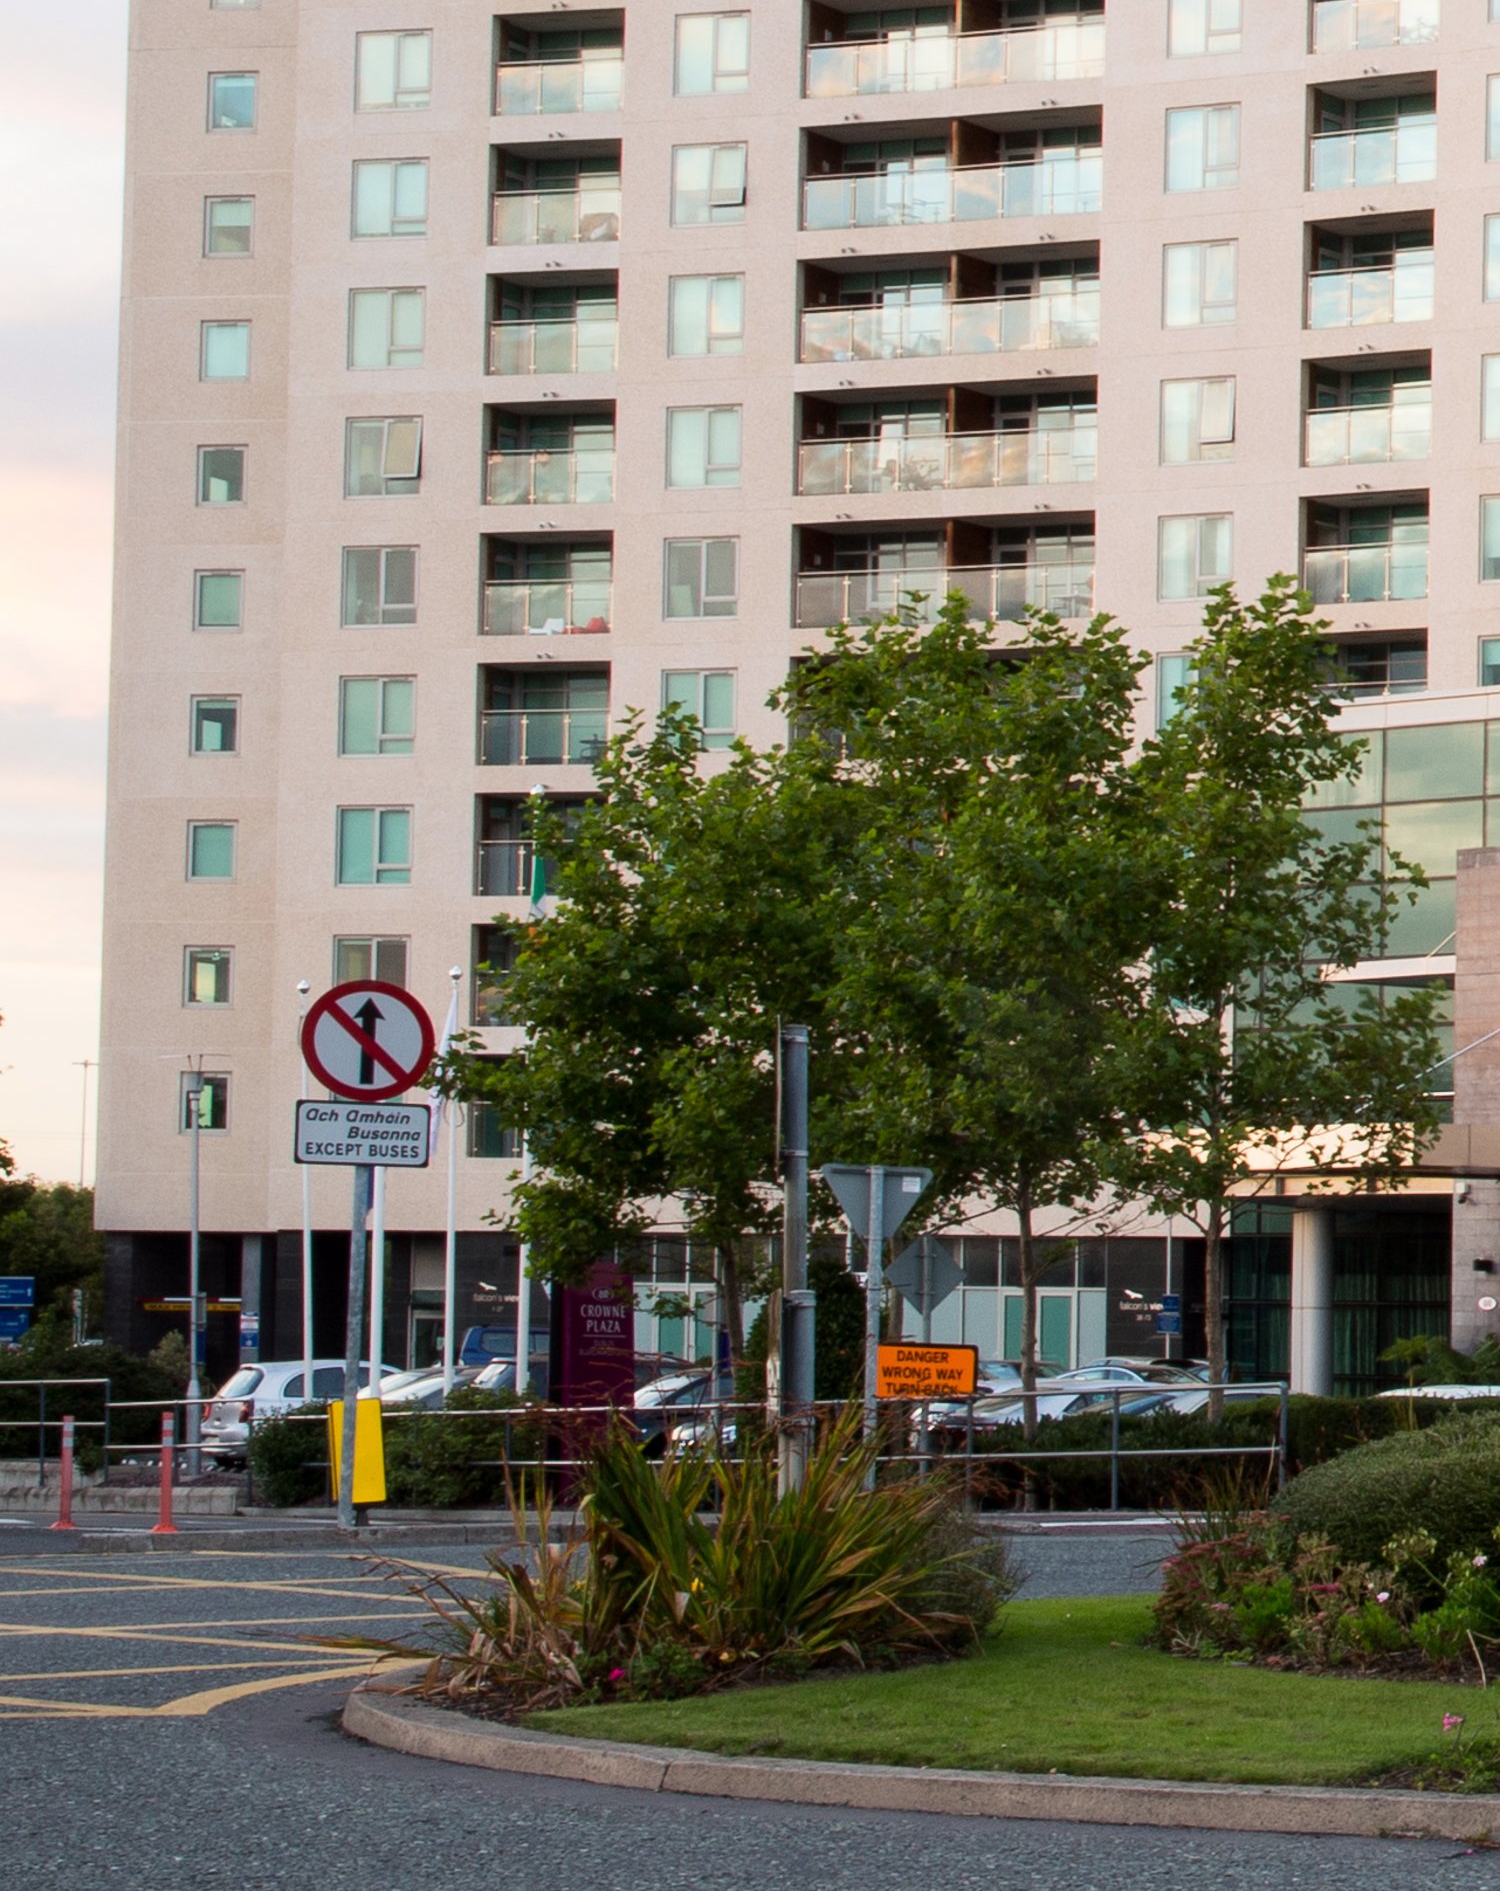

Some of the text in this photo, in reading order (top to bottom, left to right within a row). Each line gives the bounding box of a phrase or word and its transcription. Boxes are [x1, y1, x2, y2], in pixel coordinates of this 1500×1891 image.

[305, 1108, 339, 1122] Ach
[347, 1126, 421, 1141] Busanna
[305, 1142, 420, 1158] EXCEPT BUSES
[580, 1304, 626, 1318] CROWNE
[586, 1319, 621, 1333] PLAZA
[896, 1350, 949, 1363] DANGER
[882, 1366, 964, 1380] WRONG WAY
[886, 1382, 958, 1395] TURN BACK
